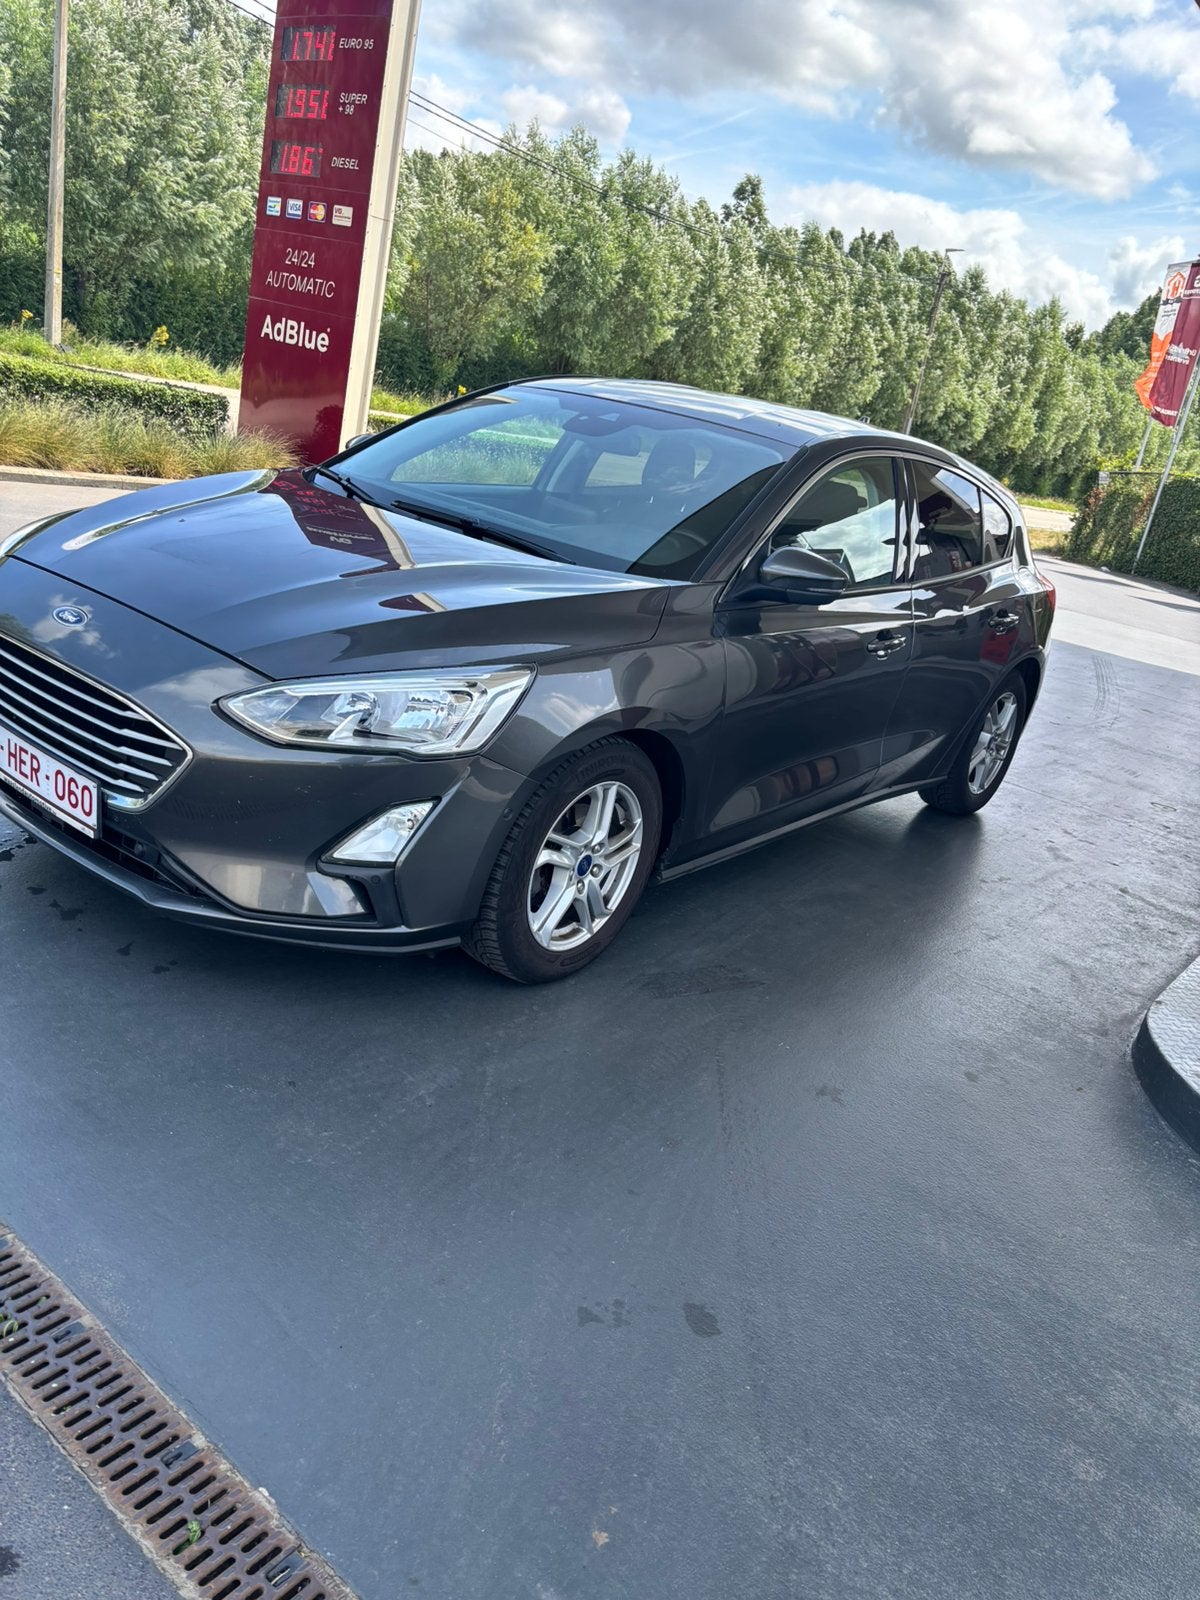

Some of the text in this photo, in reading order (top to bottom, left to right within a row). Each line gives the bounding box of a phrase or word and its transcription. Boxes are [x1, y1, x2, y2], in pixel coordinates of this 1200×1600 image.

[339, 38, 374, 50] EURO 95
[339, 92, 368, 104] SUPER
[345, 104, 354, 115] 98
[331, 156, 360, 170] DIESEL
[289, 203, 302, 212] VISA
[285, 247, 316, 268] 24/24
[265, 270, 336, 298] AUTOMATIC
[260, 314, 330, 353] AdBlue
